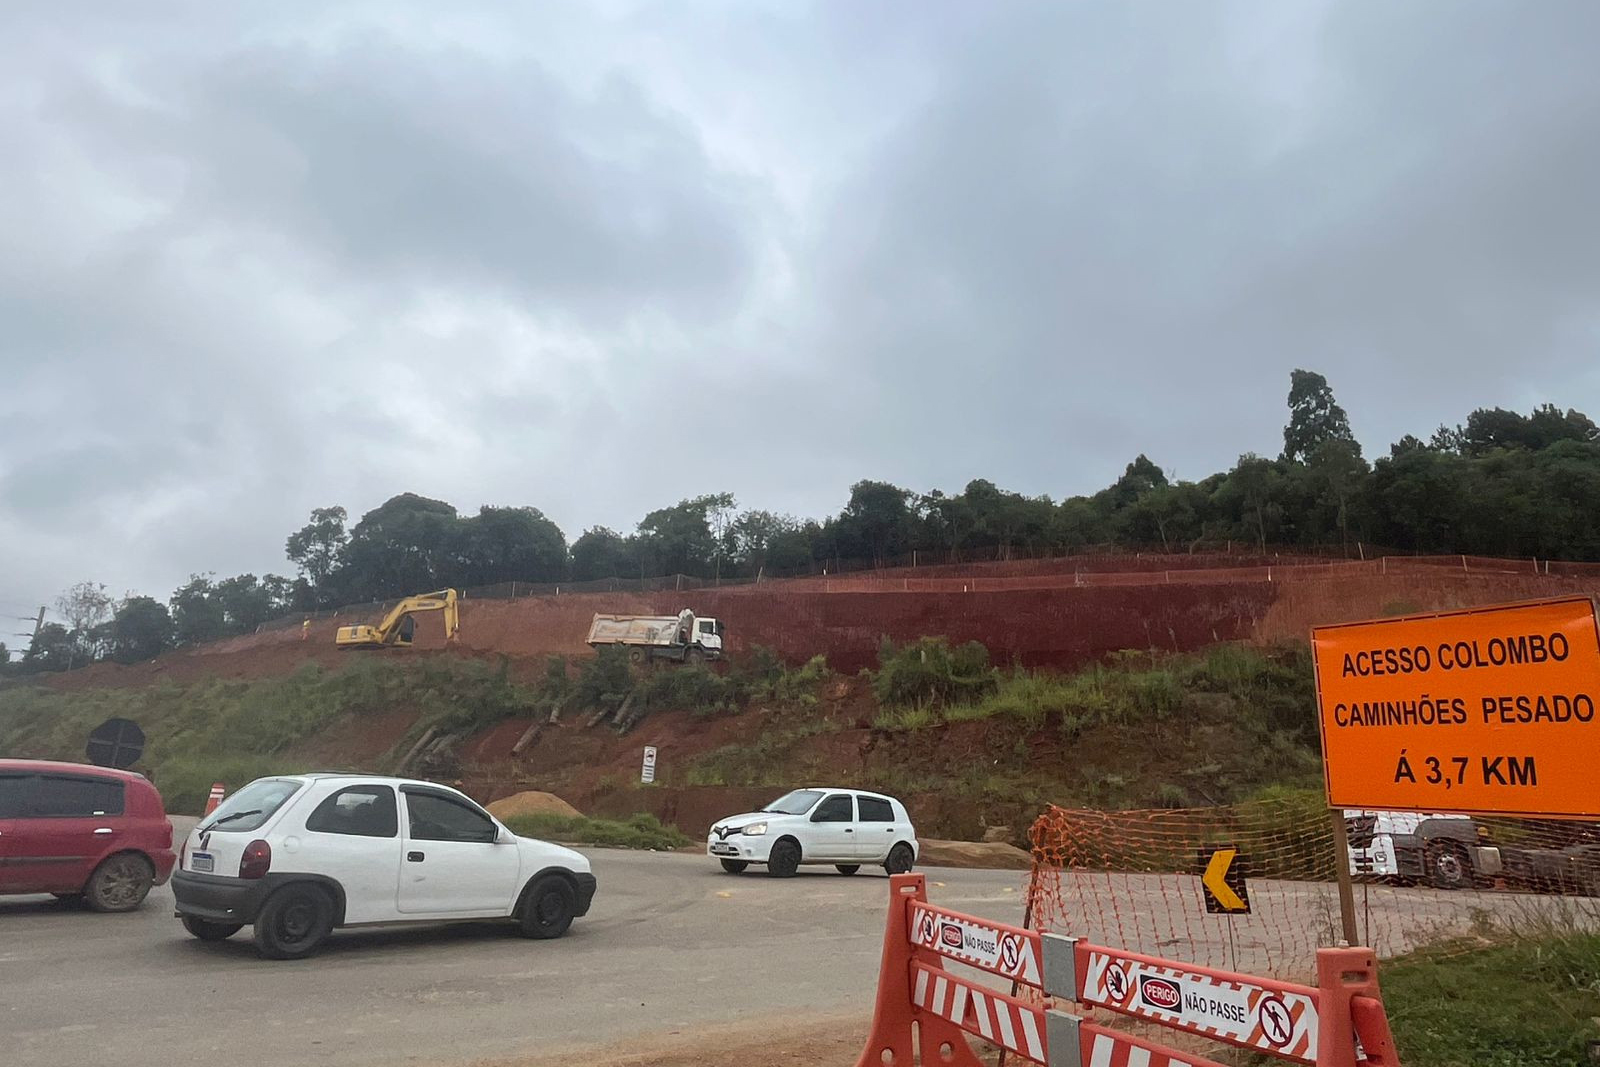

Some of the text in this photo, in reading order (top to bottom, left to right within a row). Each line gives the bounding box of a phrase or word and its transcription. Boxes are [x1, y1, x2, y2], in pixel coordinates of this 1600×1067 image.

[1342, 632, 1569, 677] ACESSO COLOMBO
[1334, 694, 1594, 727] CAMINHÕES PESADO
[1394, 749, 1538, 789] Á 3,7 KM
[976, 938, 996, 955] PASSE
[1146, 984, 1246, 1023] PERIGO NÃO PASSE
